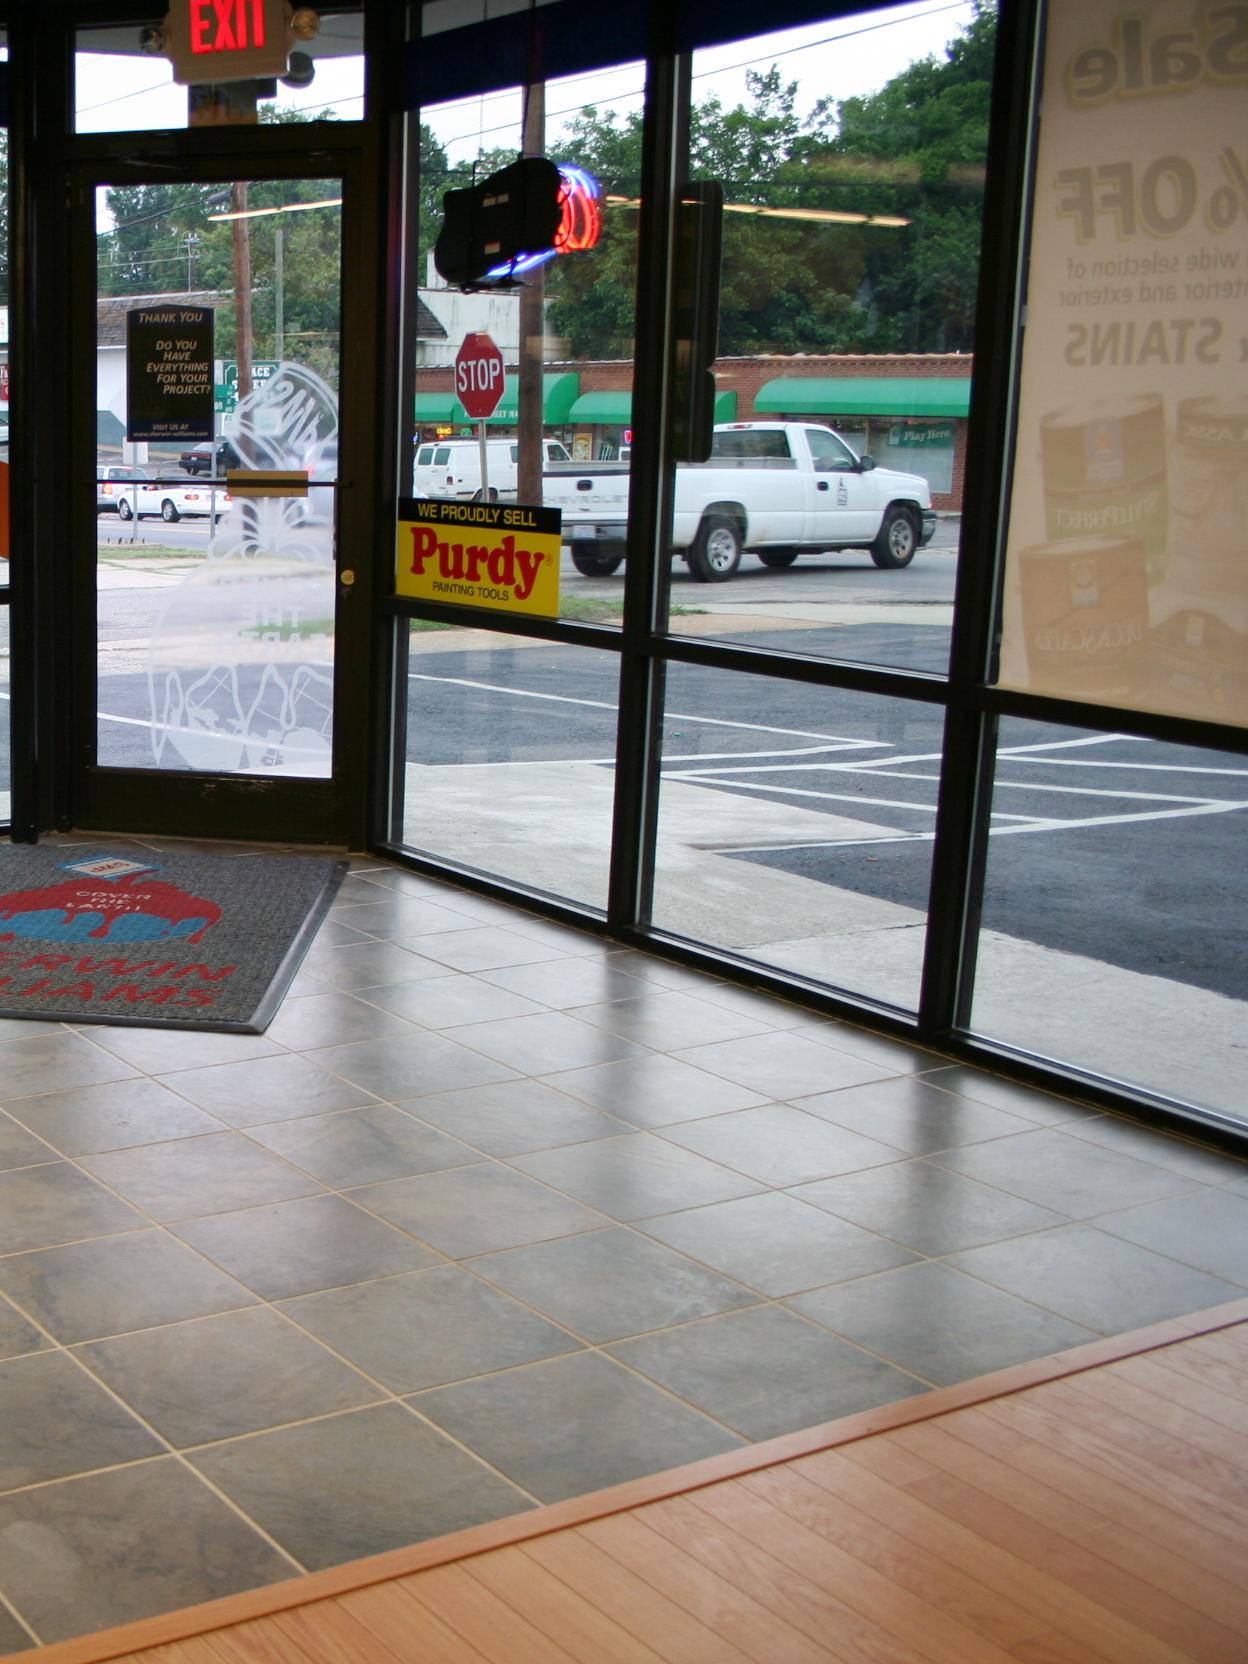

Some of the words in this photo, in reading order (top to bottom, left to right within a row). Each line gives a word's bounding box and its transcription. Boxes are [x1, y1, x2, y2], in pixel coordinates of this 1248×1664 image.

[190, 0, 265, 54] EXIT
[139, 312, 176, 323] THANK
[180, 311, 203, 322] YOU
[156, 340, 172, 350] DO
[175, 340, 197, 350] YOU
[163, 352, 191, 361] HAVE
[146, 363, 209, 372] EVERYTHING
[157, 373, 177, 383] FOR
[180, 374, 209, 383] YOUR
[457, 358, 500, 394] STOP
[163, 385, 211, 394] PROJECT?
[417, 503, 439, 518] WE
[440, 505, 501, 524] PROUDLY
[503, 510, 536, 527] SELL
[410, 527, 545, 600] Purdy
[432, 580, 475, 598] PAINTING
[477, 585, 509, 601] TOOLS
[75, 891, 152, 900] COVER
[65, 902, 141, 911] EARTH
